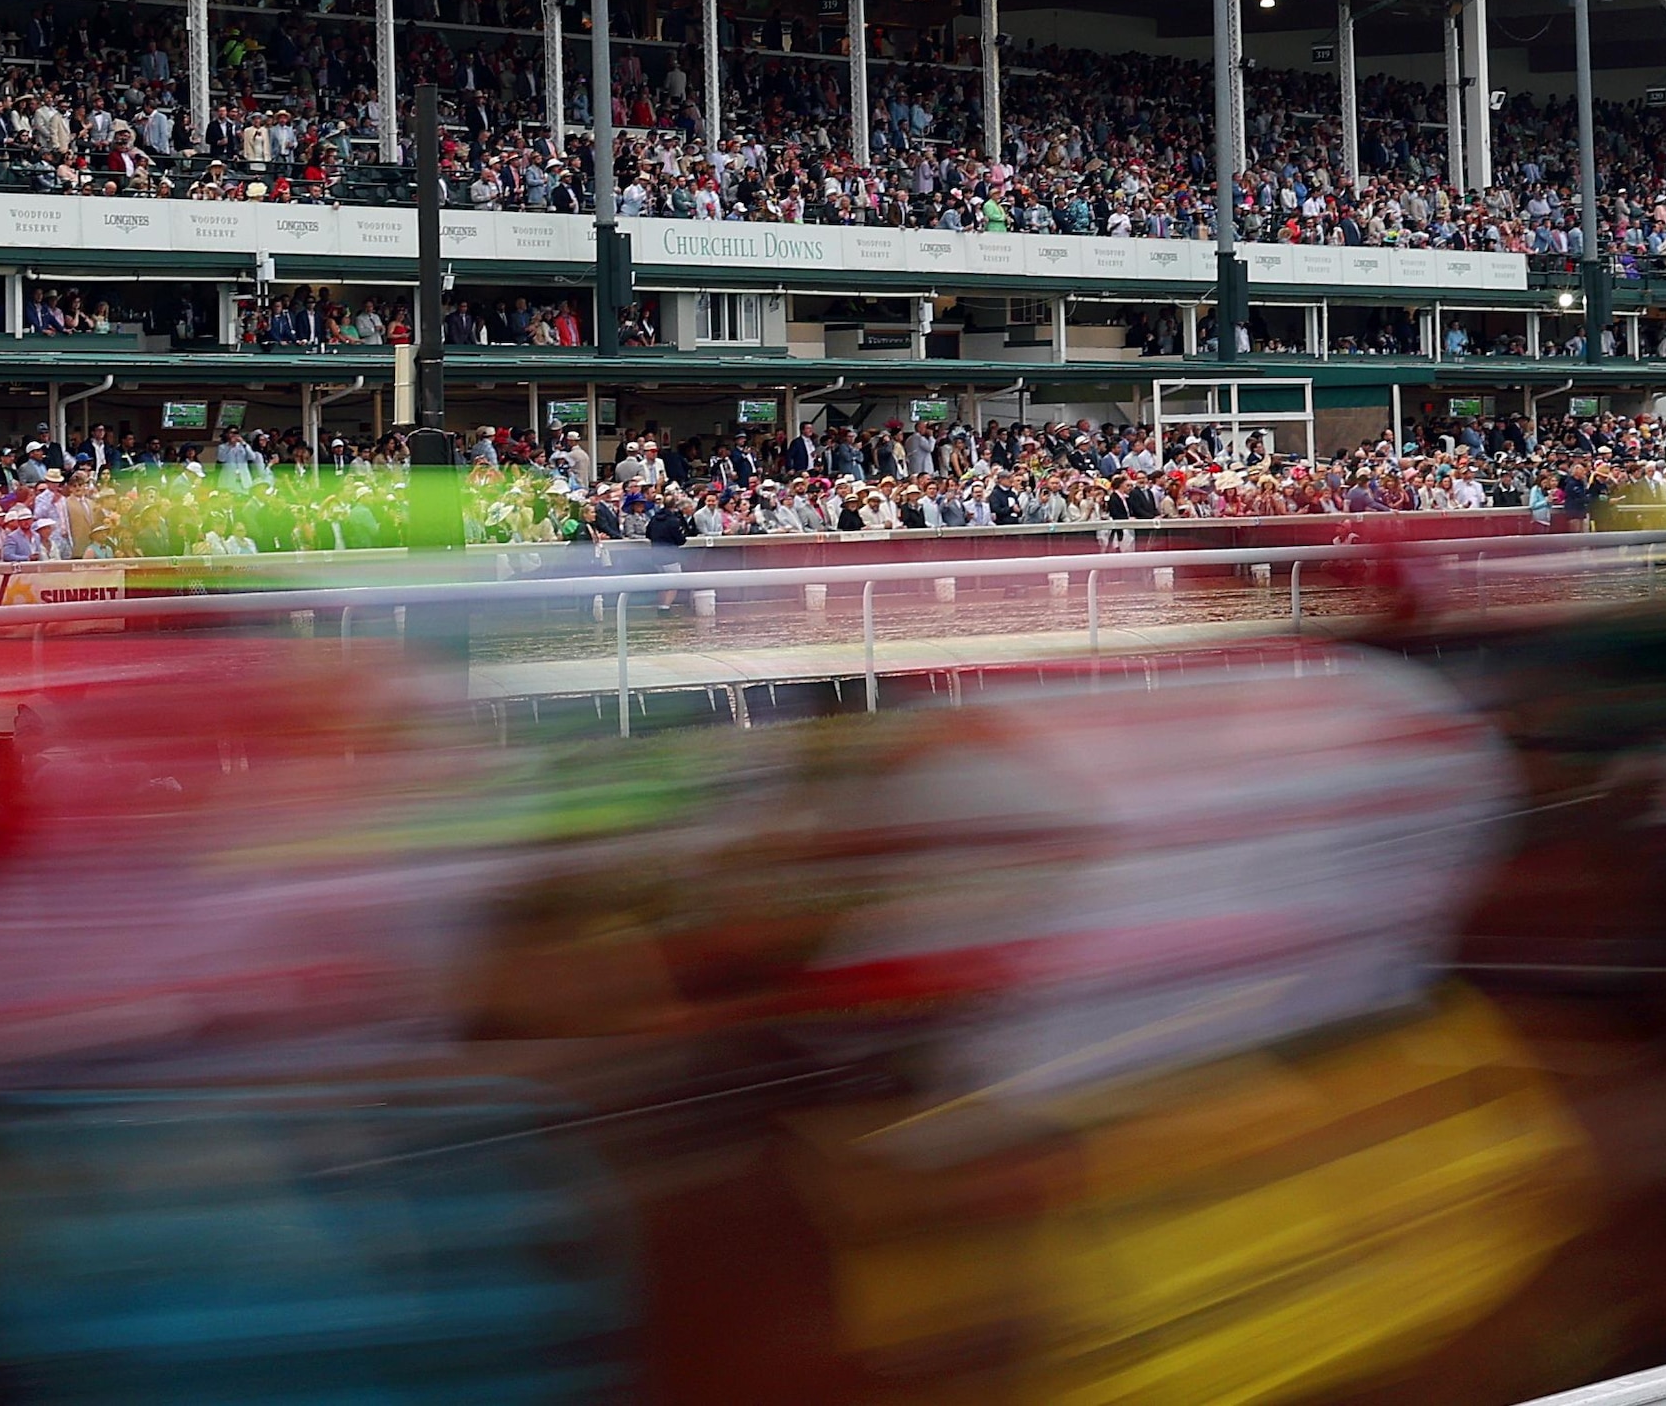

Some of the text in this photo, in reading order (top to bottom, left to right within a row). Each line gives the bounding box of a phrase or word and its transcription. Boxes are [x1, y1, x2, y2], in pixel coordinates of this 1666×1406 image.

[9, 208, 61, 220] WOODFORD
[104, 214, 149, 226] LONGINES
[191, 214, 239, 226] WOODFORD
[15, 222, 59, 233] RESERVE
[277, 220, 319, 232] LONGINES
[357, 220, 403, 231] WOODFORD
[439, 226, 477, 237] ONGINES
[195, 228, 237, 238] RESERVE
[362, 233, 400, 244] RESERVE
[663, 228, 823, 260] CHURCHILL DOWNS
[40, 587, 118, 603] SUNBELT
